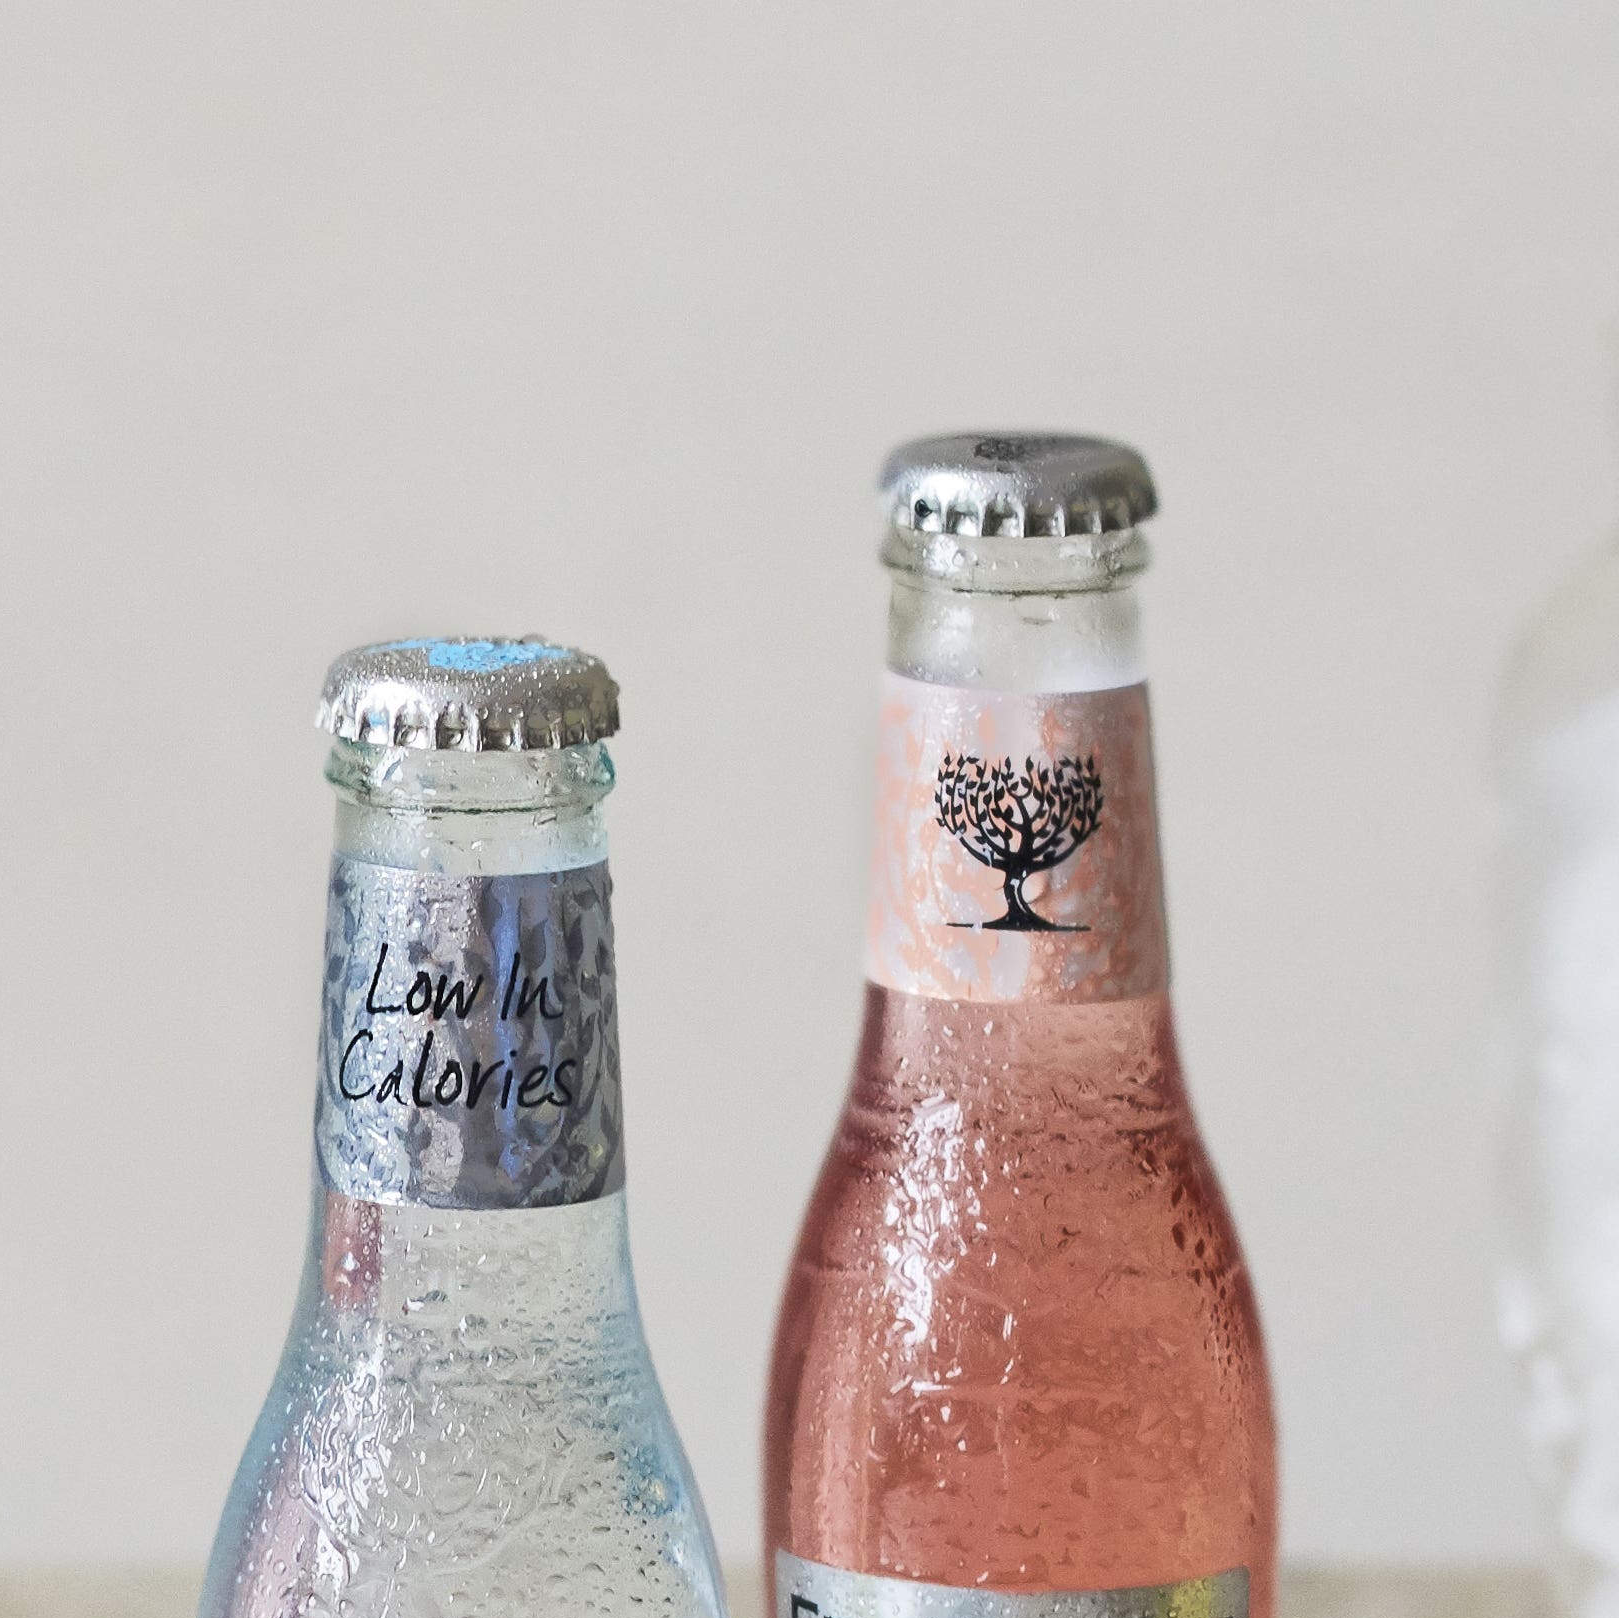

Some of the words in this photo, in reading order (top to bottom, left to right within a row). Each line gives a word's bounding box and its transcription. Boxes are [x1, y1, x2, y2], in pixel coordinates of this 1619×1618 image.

[366, 942, 484, 1021] Low
[500, 952, 565, 1021] In
[339, 1028, 576, 1108] Calories
